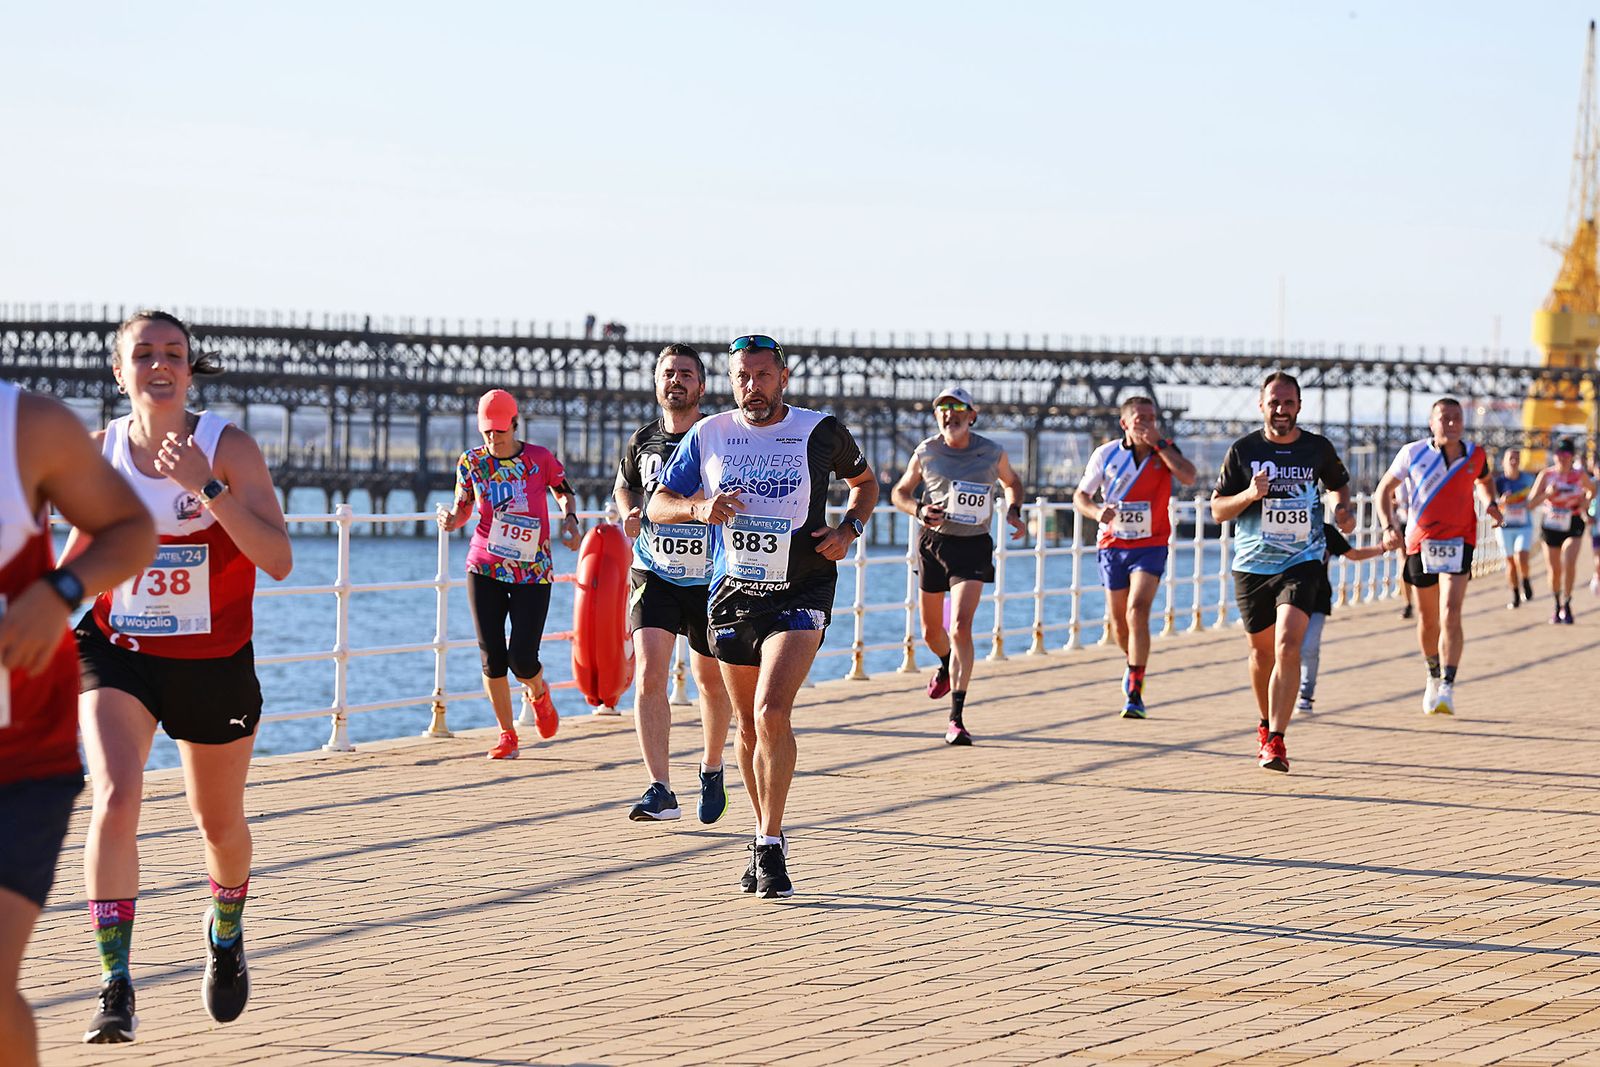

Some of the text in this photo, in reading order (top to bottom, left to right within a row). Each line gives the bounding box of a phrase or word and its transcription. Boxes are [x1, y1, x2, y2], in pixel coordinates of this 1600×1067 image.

[721, 454, 803, 468] RUNNERS
[739, 460, 802, 484] Palmera
[1251, 460, 1314, 481] 10 HUELVA
[957, 492, 985, 507] 608
[1265, 510, 1308, 524] 1038
[501, 523, 533, 542] 195
[652, 536, 704, 555] 1058
[732, 530, 778, 553] 883
[1428, 546, 1456, 557] 953
[125, 616, 172, 630] Wayalia
